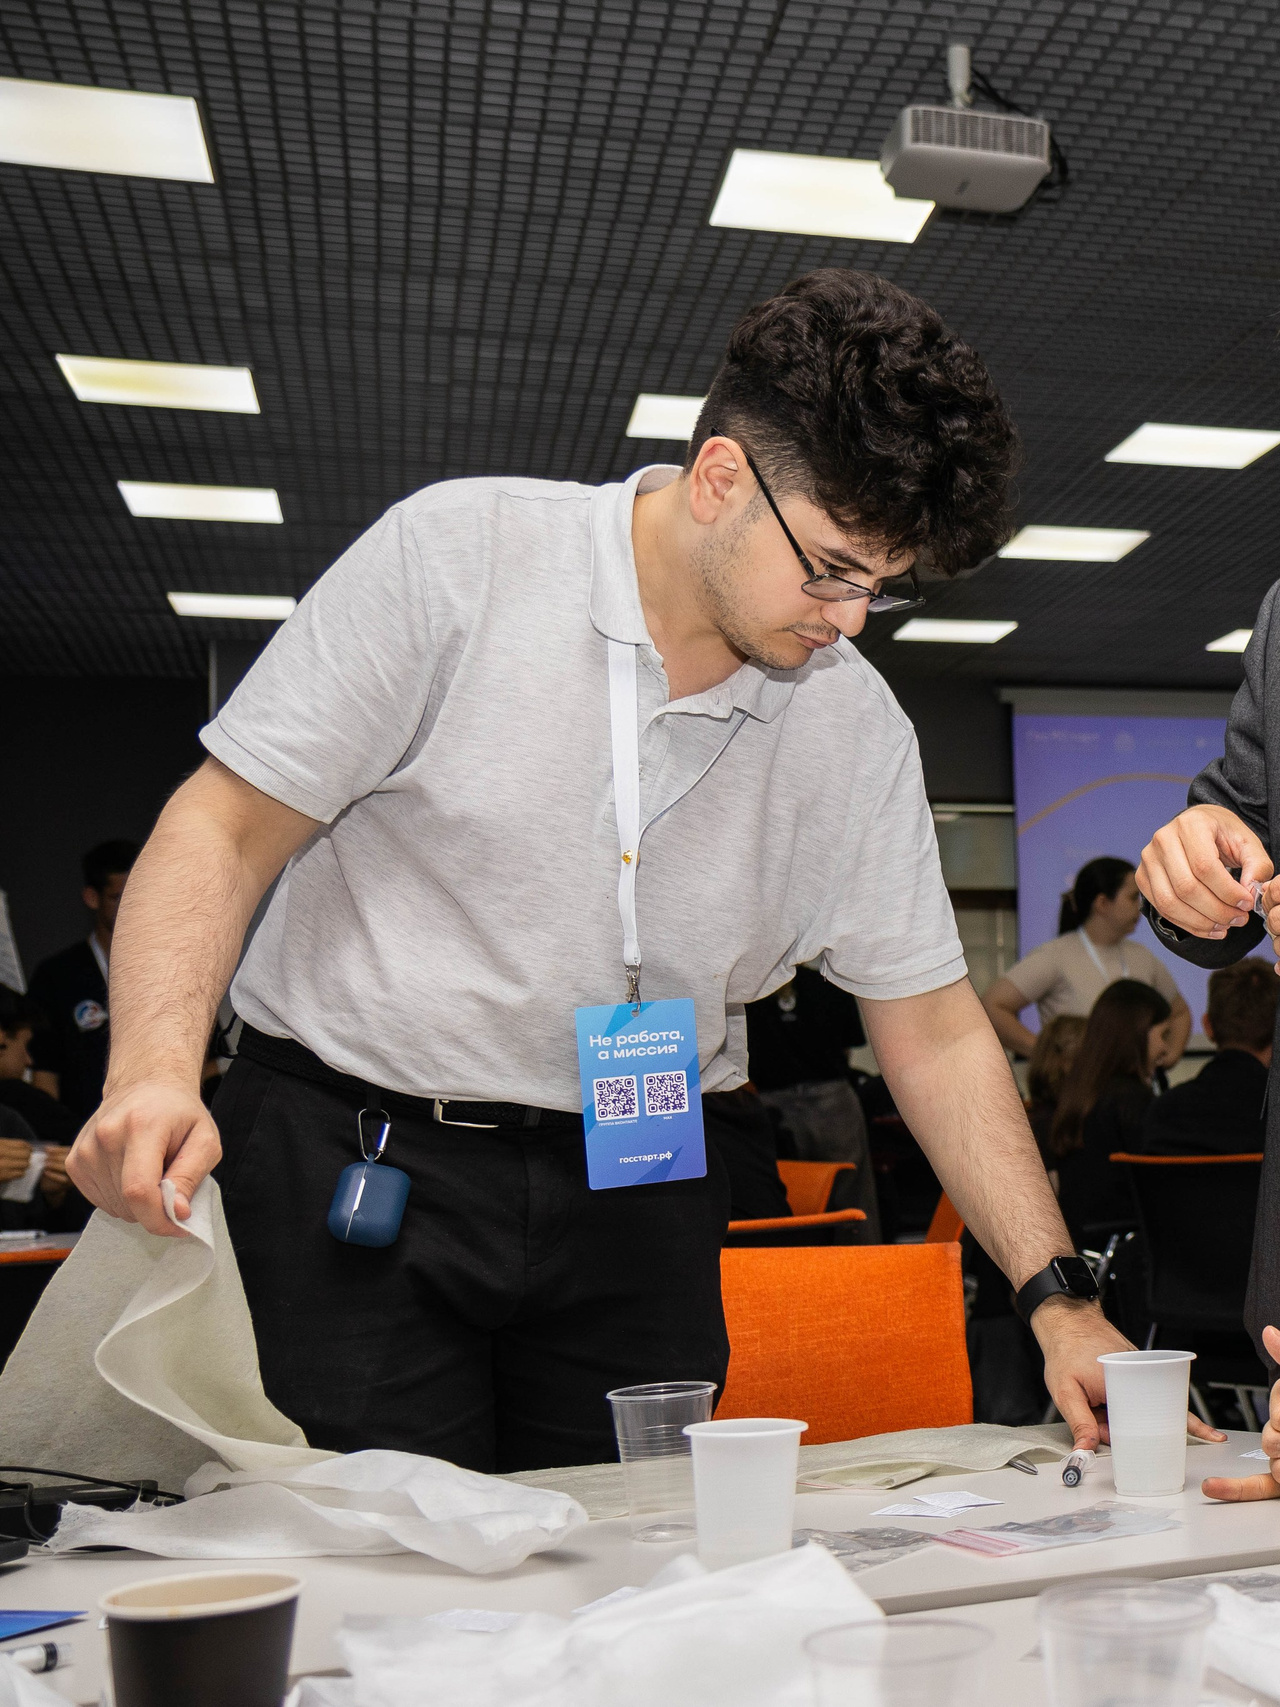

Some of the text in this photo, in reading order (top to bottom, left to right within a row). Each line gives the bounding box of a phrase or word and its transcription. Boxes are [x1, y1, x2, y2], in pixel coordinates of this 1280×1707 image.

[589, 1029, 685, 1047] Не работа,
[598, 1044, 678, 1060] а миссия
[619, 1150, 673, 1164] госстарт.рф
